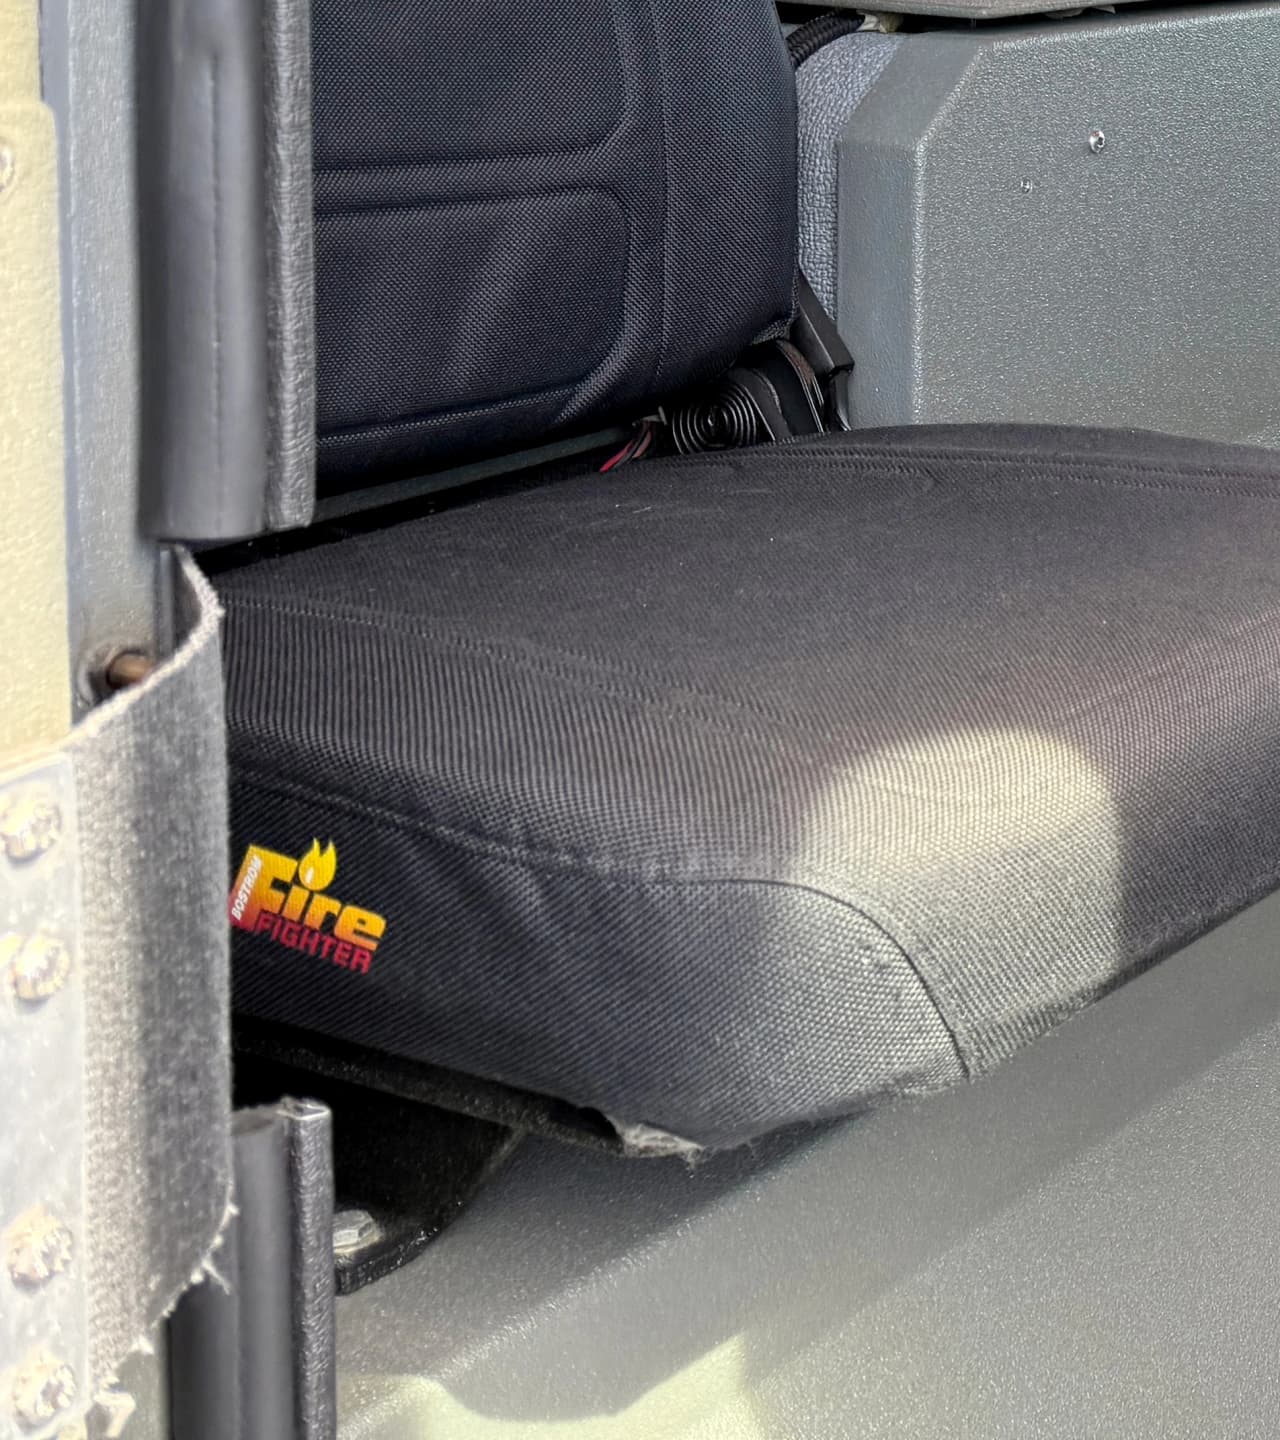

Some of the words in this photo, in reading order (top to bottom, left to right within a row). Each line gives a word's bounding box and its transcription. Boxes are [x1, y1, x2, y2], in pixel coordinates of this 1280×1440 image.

[228, 837, 387, 952] Fire
[231, 854, 262, 921] BOSTROM
[256, 912, 373, 976] FIGHTER
